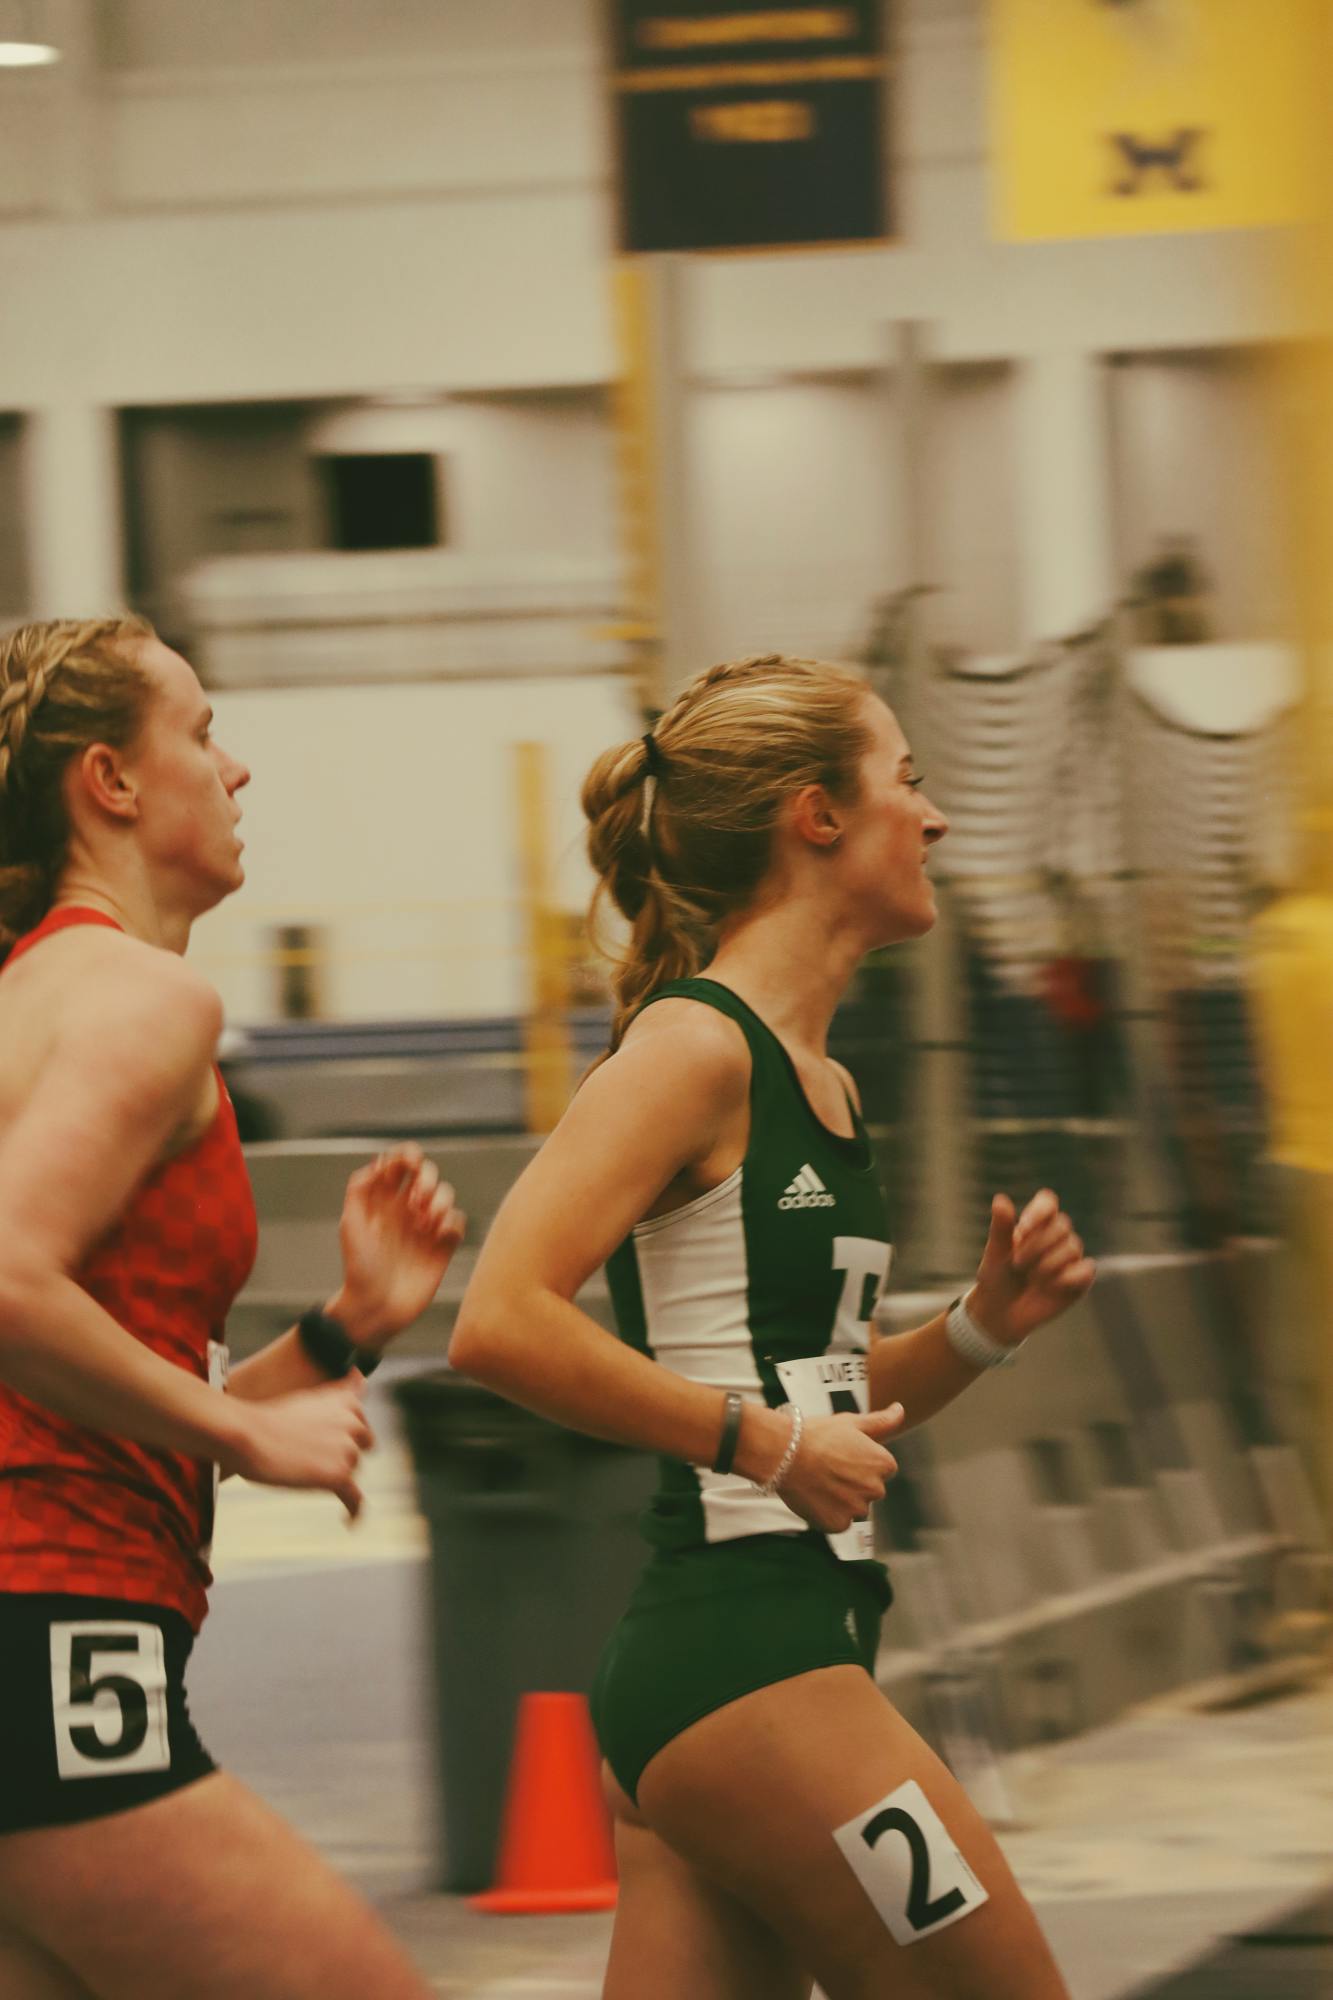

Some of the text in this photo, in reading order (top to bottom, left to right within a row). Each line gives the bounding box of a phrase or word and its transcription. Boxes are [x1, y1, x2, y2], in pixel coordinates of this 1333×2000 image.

[777, 1192, 836, 1210] adidas
[68, 1634, 149, 1761] 5
[860, 1807, 967, 1932] 2
